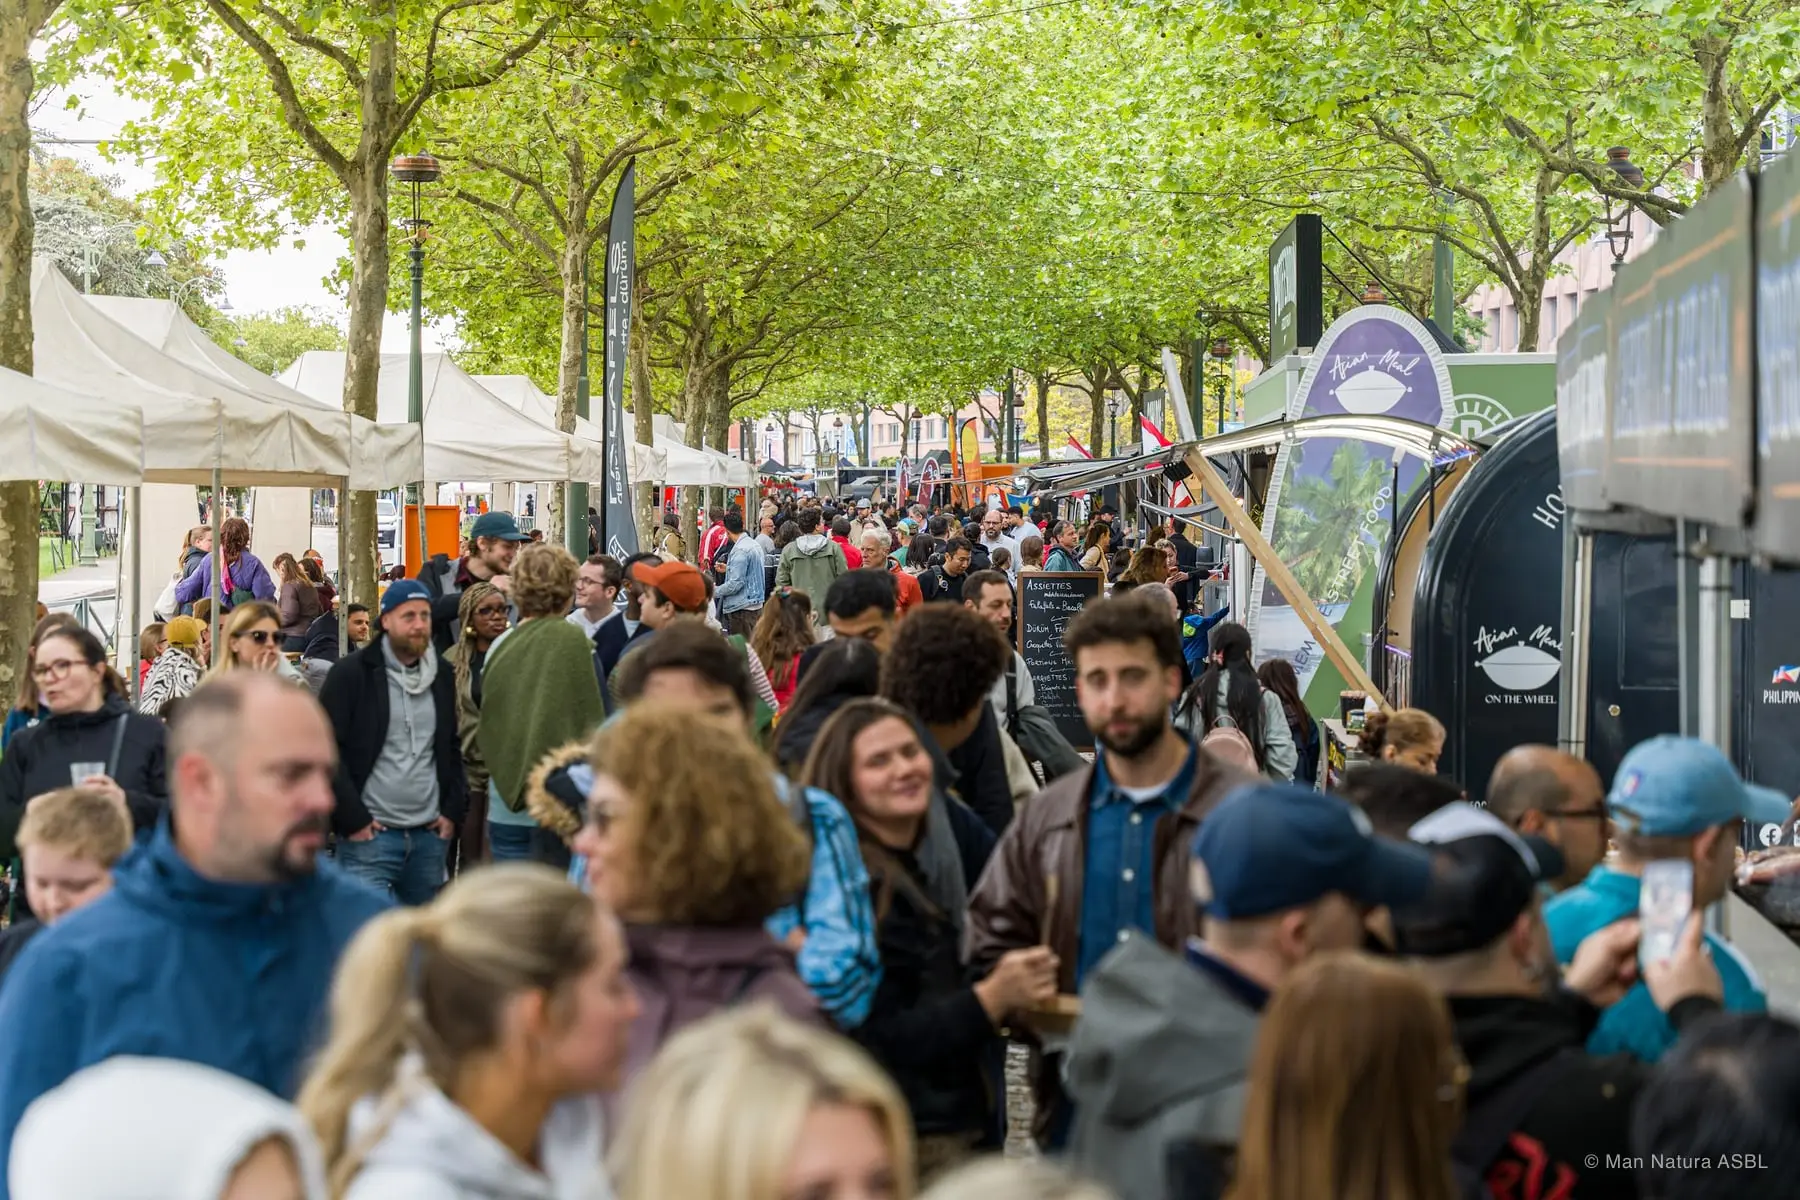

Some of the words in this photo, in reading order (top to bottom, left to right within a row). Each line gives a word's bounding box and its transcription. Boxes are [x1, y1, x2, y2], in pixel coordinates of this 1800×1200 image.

[1329, 351, 1368, 381] Asian
[1378, 348, 1420, 376] Meal
[1327, 534, 1365, 603] STREET
[1360, 486, 1393, 536] FOOD
[1473, 625, 1518, 653] Asian
[1484, 695, 1501, 704] ON
[1503, 695, 1522, 704] THE
[1523, 695, 1557, 704] WHEEL
